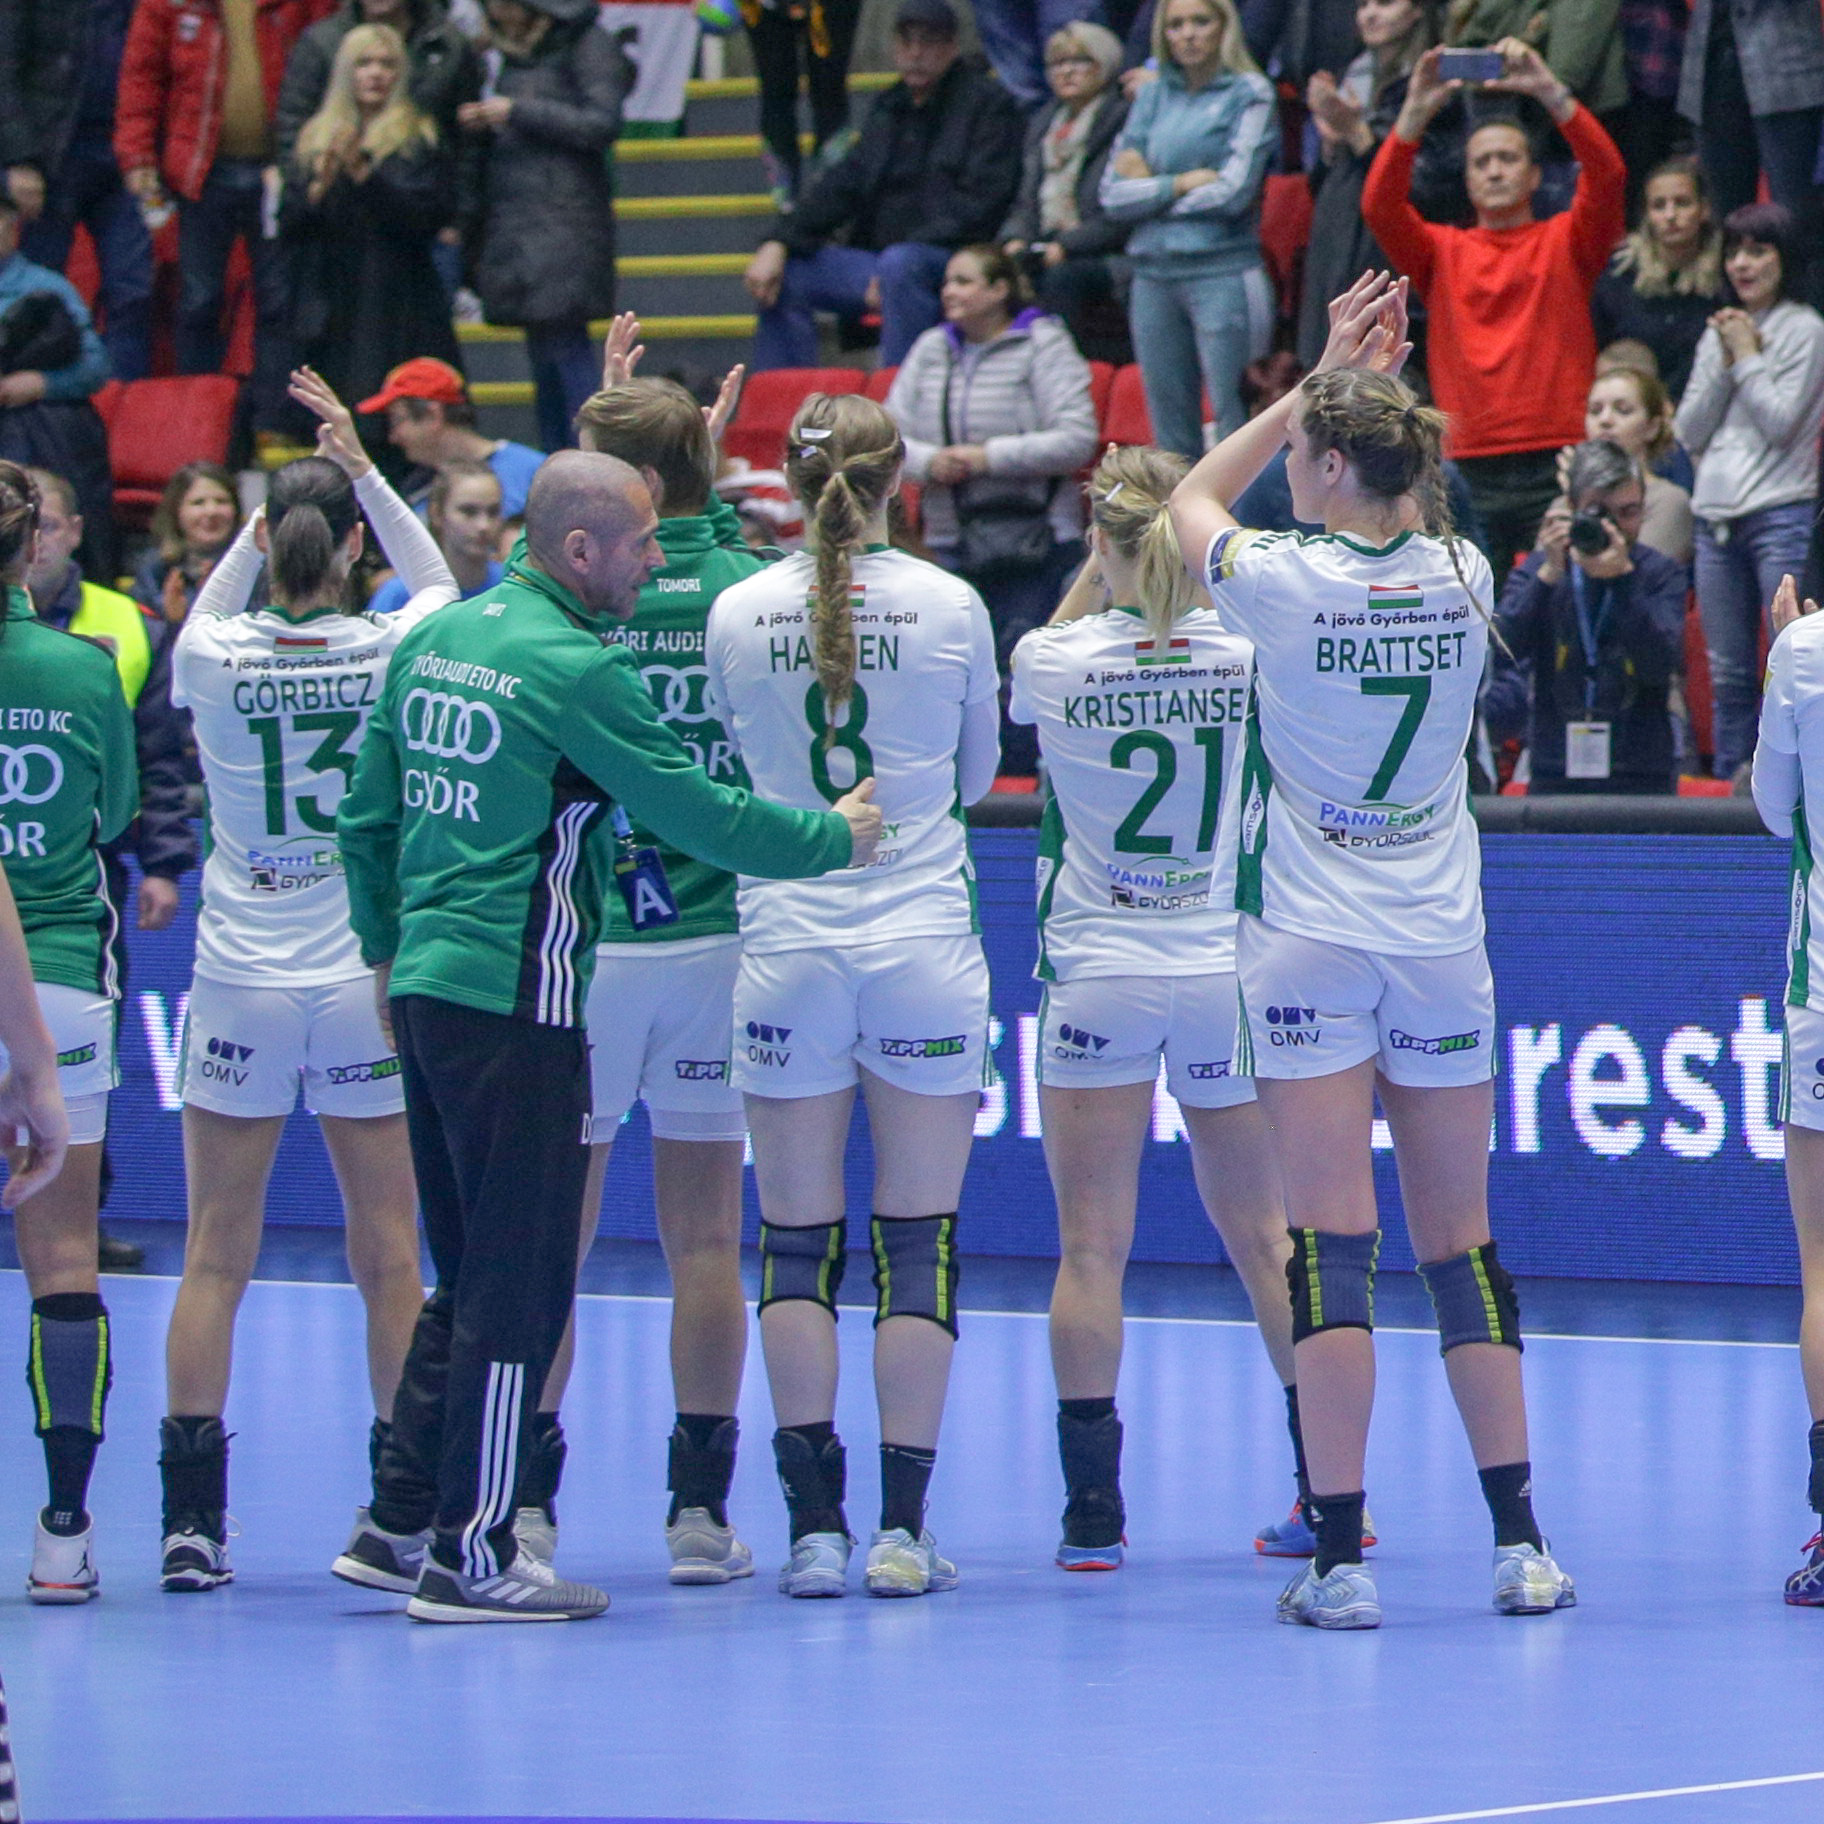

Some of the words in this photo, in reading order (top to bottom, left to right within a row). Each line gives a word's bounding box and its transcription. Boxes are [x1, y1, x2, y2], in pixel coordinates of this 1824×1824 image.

[657, 578, 700, 593] TOMORI
[755, 615, 765, 627] A
[1314, 613, 1326, 625] A
[653, 630, 705, 652] AUDI
[769, 634, 899, 674] HAEN
[1316, 631, 1467, 674] BRATTSET
[223, 657, 232, 669] A
[495, 673, 522, 700] KC
[1085, 672, 1096, 685] A
[233, 672, 377, 715] GÖRBICZ
[8, 708, 44, 731] ETO
[49, 709, 73, 734] KC
[1065, 687, 1250, 728] KRISTIANSE
[804, 679, 876, 805] 8
[1361, 675, 1432, 801] 7
[247, 710, 364, 837] 13
[404, 767, 480, 823] GYŐR
[1110, 727, 1224, 855] 21
[634, 877, 673, 924] A
[1270, 1029, 1321, 1047] OMV
[749, 1045, 791, 1068] OMV
[201, 1061, 249, 1087] OMV
